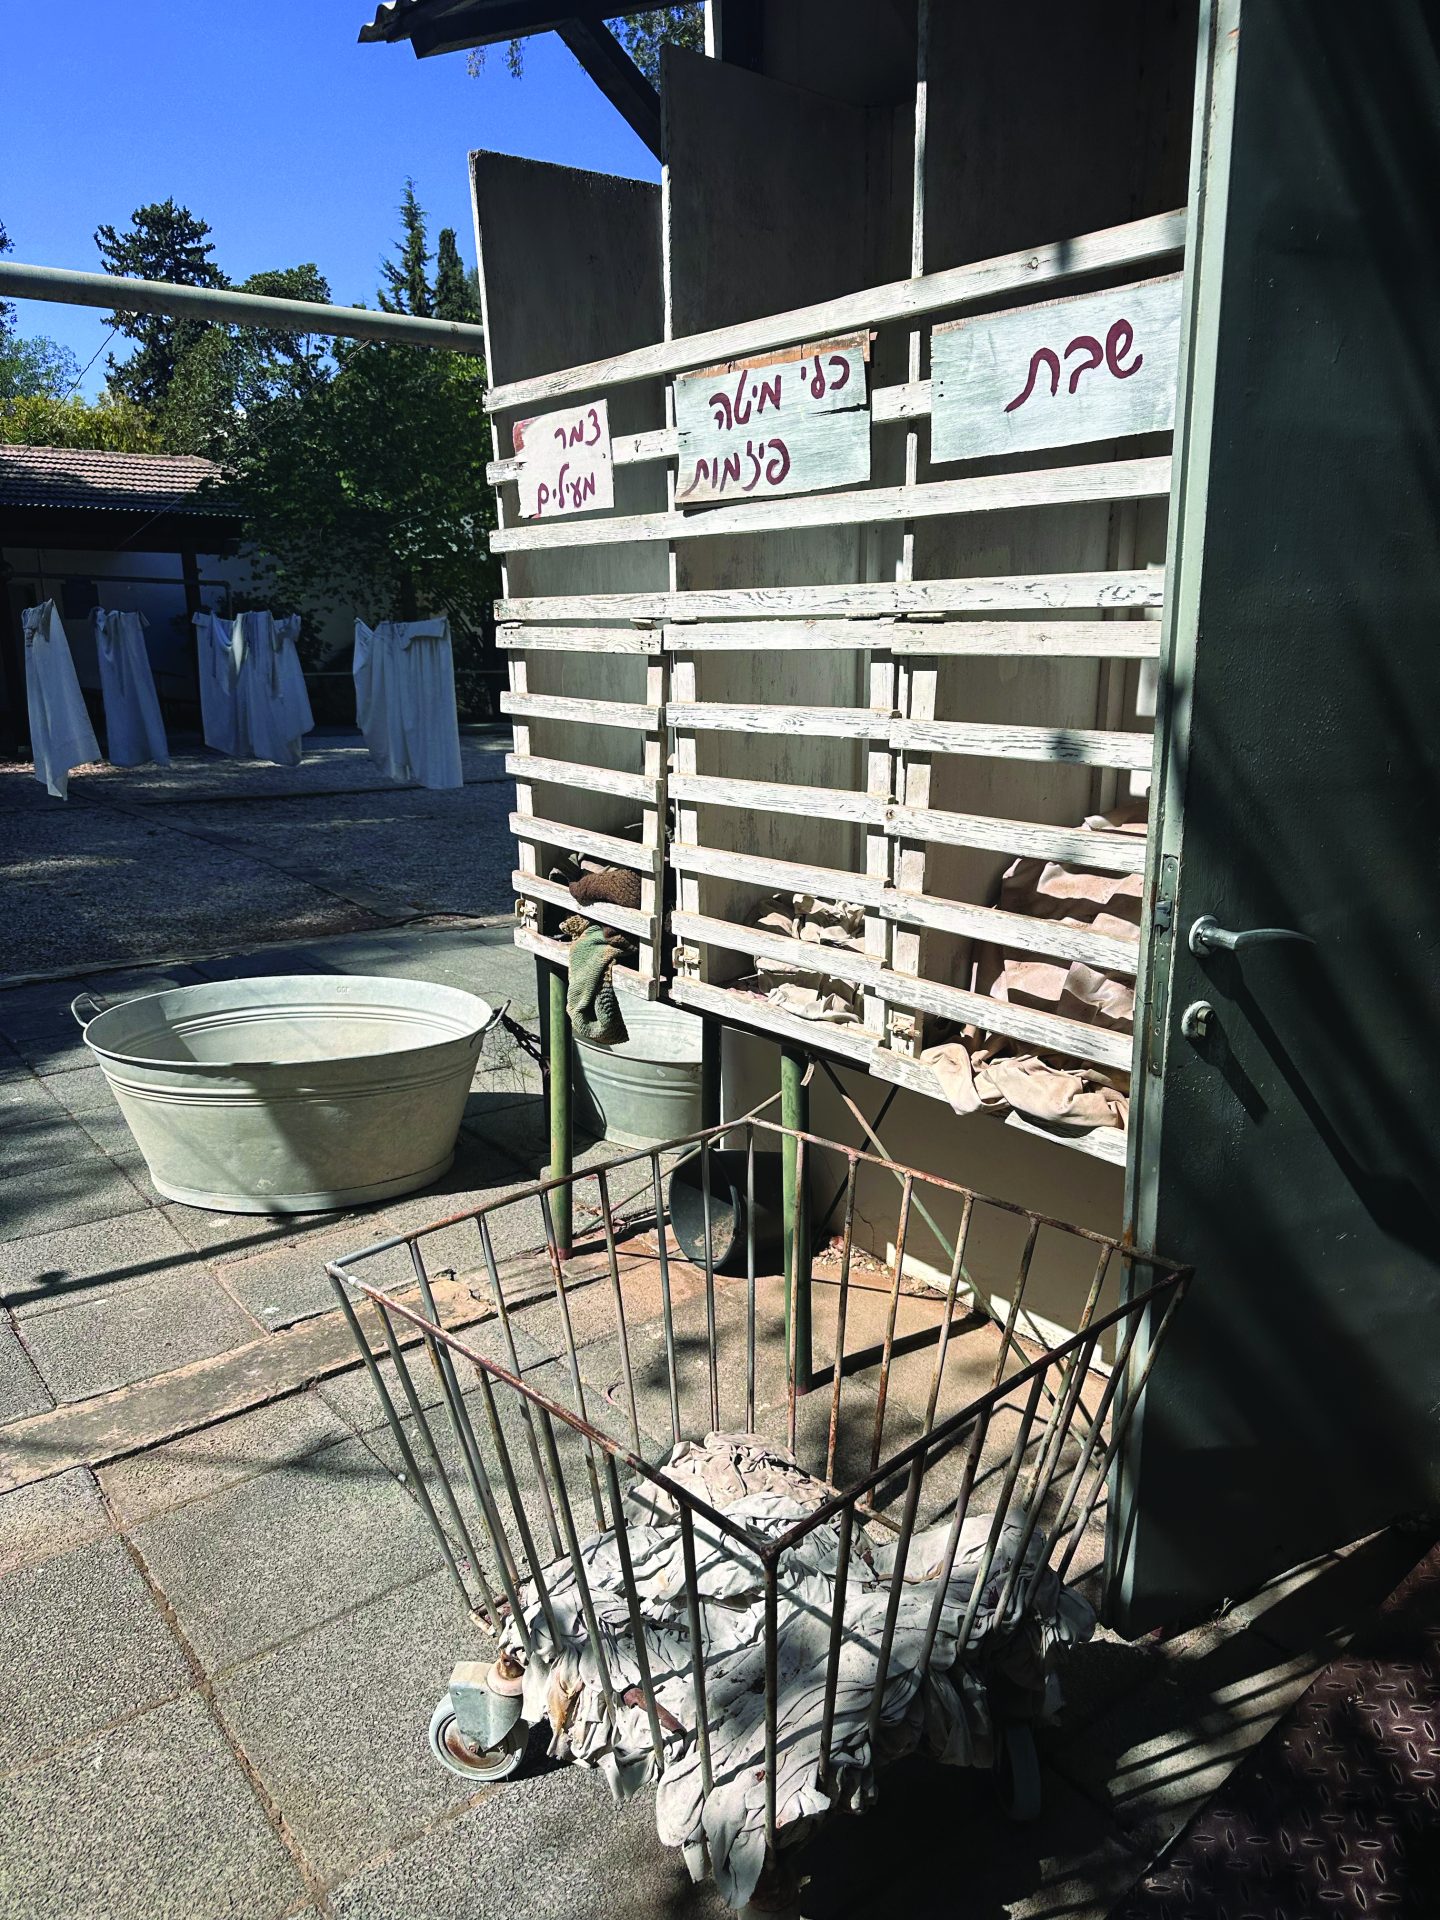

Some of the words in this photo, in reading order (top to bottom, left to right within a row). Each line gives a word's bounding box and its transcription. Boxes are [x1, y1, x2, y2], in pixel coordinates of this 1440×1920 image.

[801, 355, 850, 399] כלי
[1004, 318, 1143, 413] שבת
[709, 369, 782, 431] מיטה
[554, 408, 601, 450] צמר
[537, 462, 596, 514] מעילים
[680, 438, 791, 498] פיזמות
